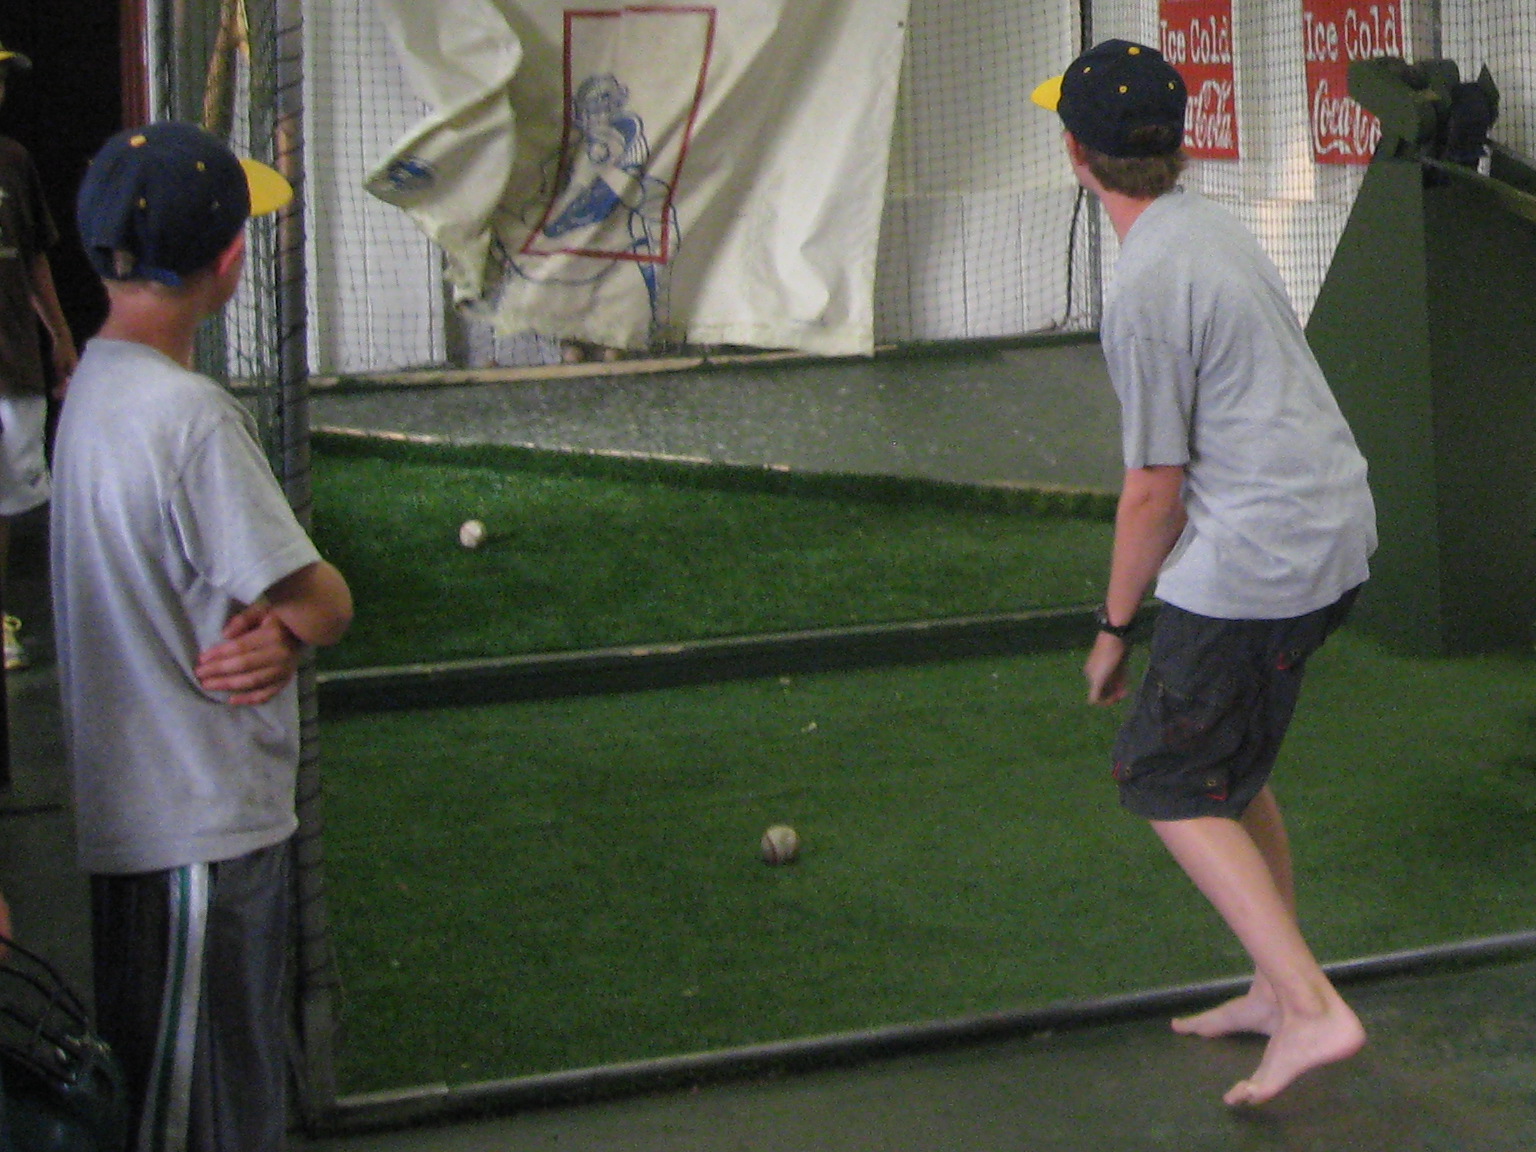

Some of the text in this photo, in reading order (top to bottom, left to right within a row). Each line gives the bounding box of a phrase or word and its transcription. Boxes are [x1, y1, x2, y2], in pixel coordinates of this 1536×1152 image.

[1160, 14, 1232, 65] Ice Cold
[1304, 4, 1400, 62] Ice Cold
